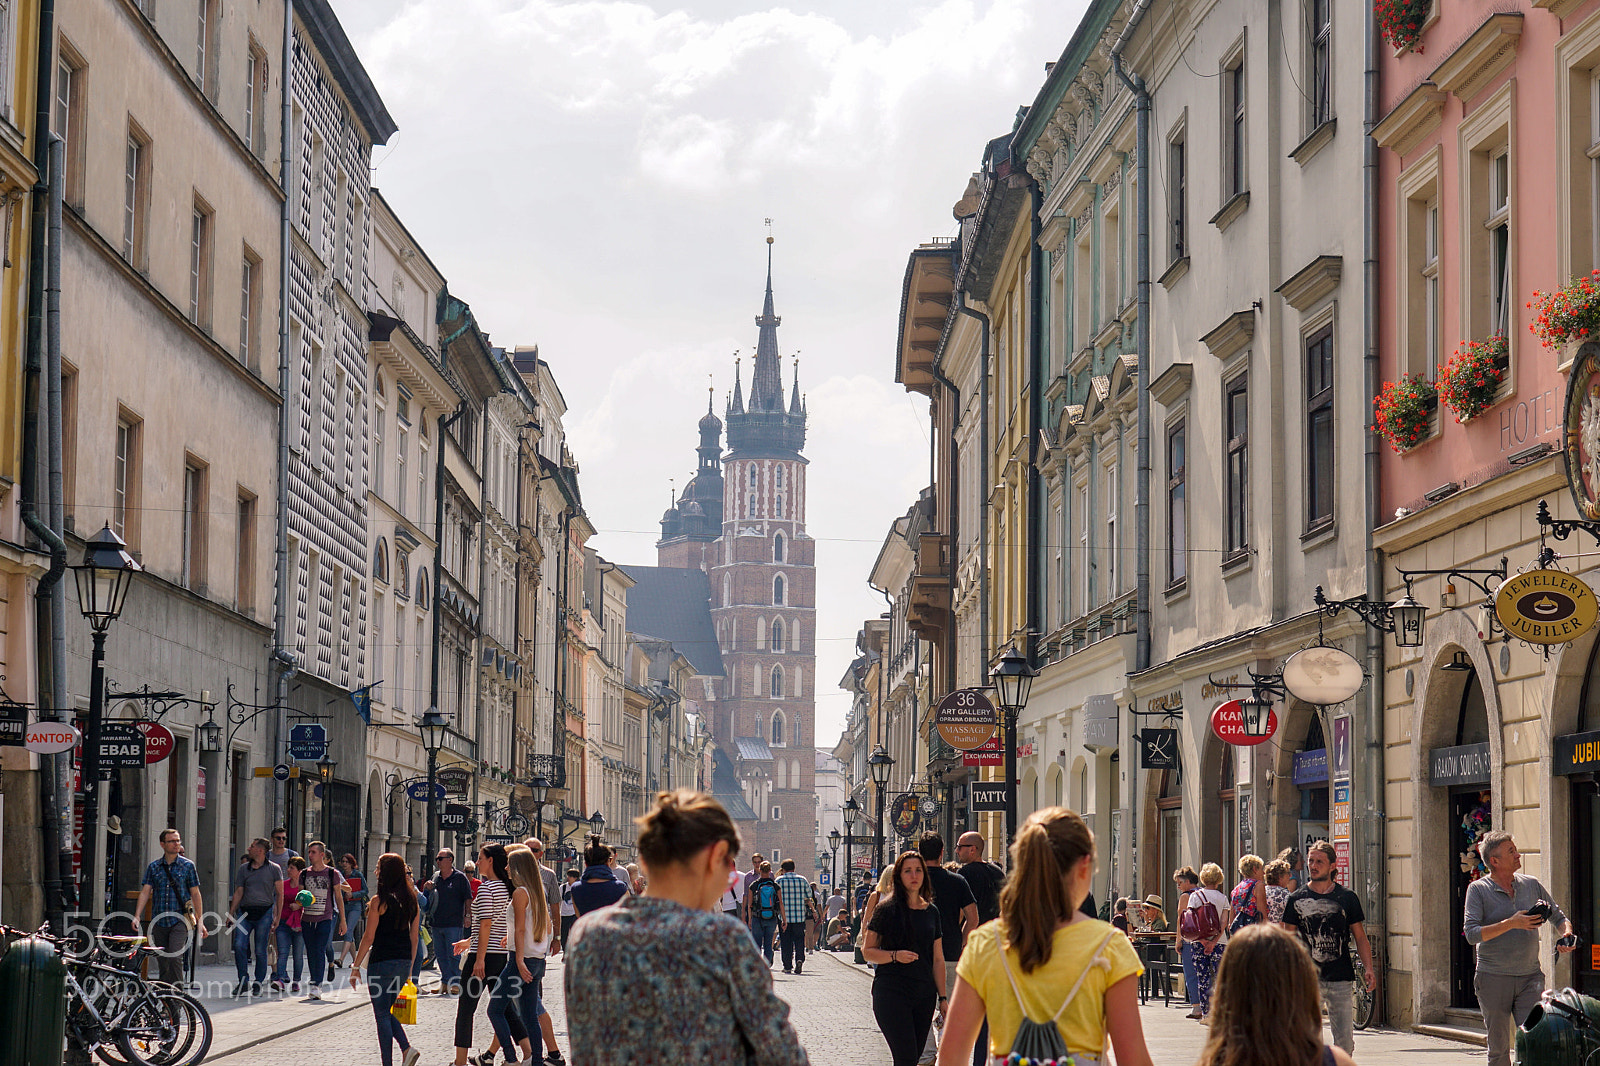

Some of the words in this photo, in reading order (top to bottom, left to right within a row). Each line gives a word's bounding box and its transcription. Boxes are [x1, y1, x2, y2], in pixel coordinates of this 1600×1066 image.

[1500, 386, 1564, 451] HOTEL
[1505, 576, 1587, 600] JEWELLERY
[1405, 619, 1418, 632] 42
[1511, 617, 1582, 637] JUBILER
[956, 692, 975, 706] 36
[958, 708, 991, 716] GALLERY
[944, 726, 987, 734] MASSAGE
[1219, 725, 1272, 734] CHAE
[146, 737, 167, 746] TOR
[99, 745, 141, 756] EBAB
[441, 815, 464, 824] PUB
[821, 874, 829, 884] P
